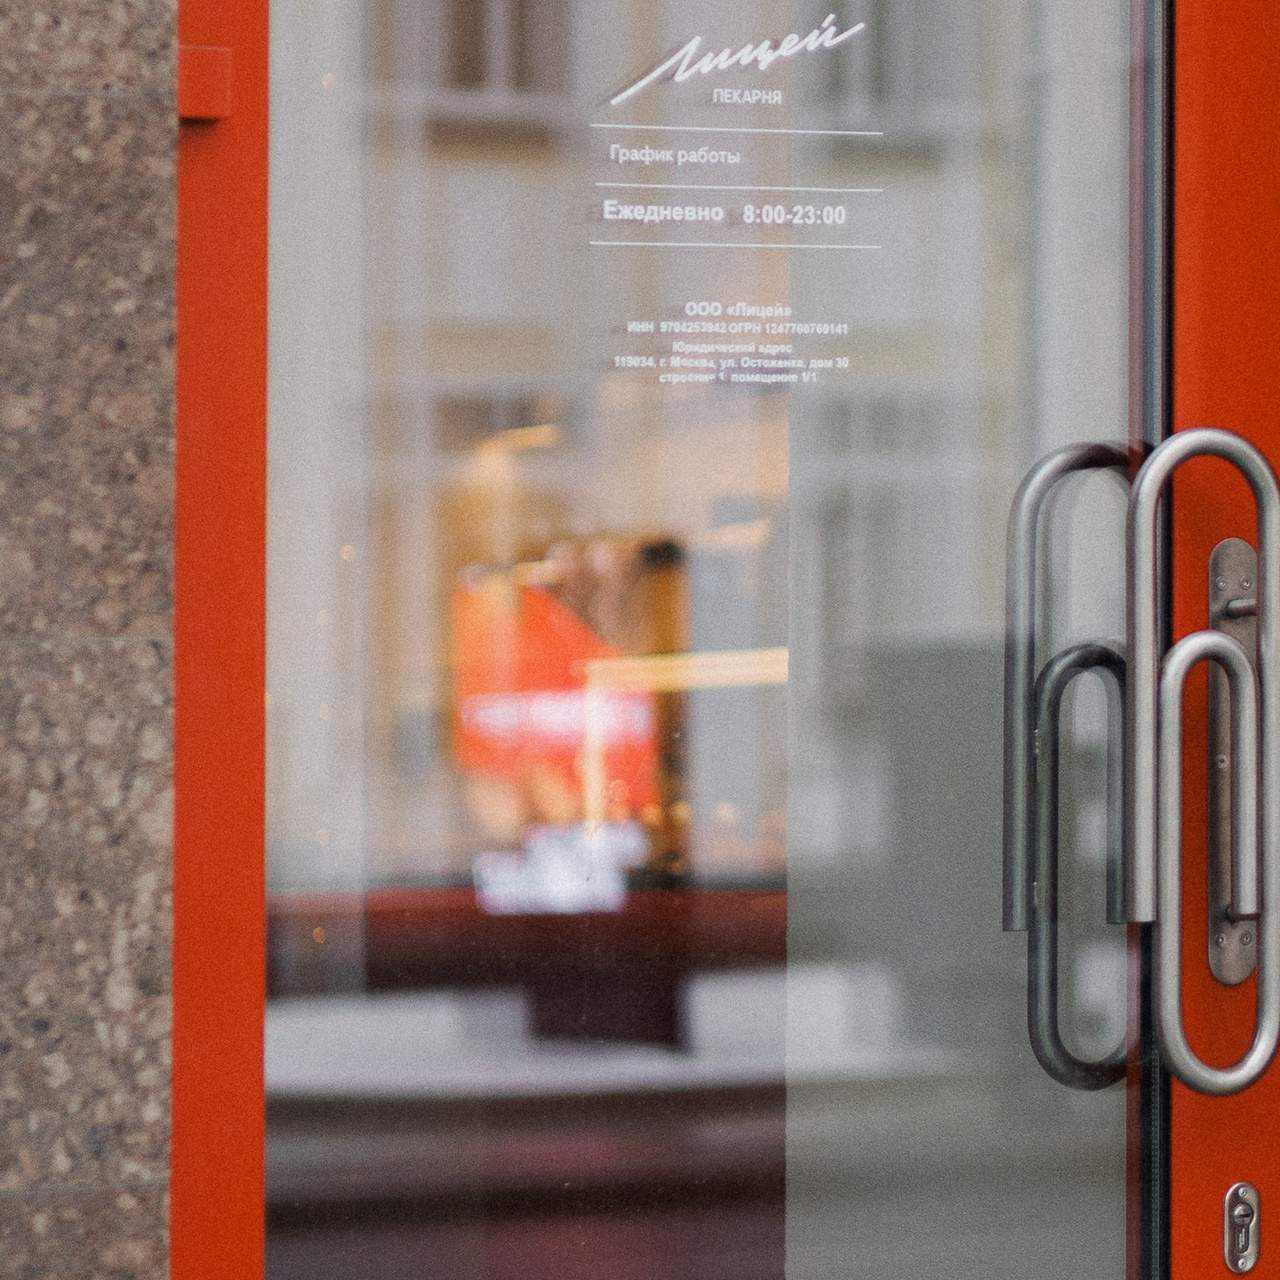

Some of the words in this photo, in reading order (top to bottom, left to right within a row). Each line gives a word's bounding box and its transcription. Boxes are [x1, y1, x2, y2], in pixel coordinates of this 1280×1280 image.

[610, 13, 866, 106] Лицей
[712, 88, 782, 105] ПЕКАРНЯ
[609, 144, 674, 165] График
[677, 146, 741, 166] работы
[603, 198, 725, 223] Ежедневно
[742, 203, 847, 225] 8:00-23:00
[684, 301, 722, 316] ООО
[726, 302, 793, 318] «Лицей»
[626, 321, 655, 333] ИНН
[728, 322, 762, 334] ОГРН
[671, 341, 756, 354] Юридический
[757, 343, 793, 355] адрес
[809, 358, 833, 369] дом
[835, 357, 849, 368] 30
[730, 373, 799, 384] помещение
[801, 371, 818, 383] 1/1
